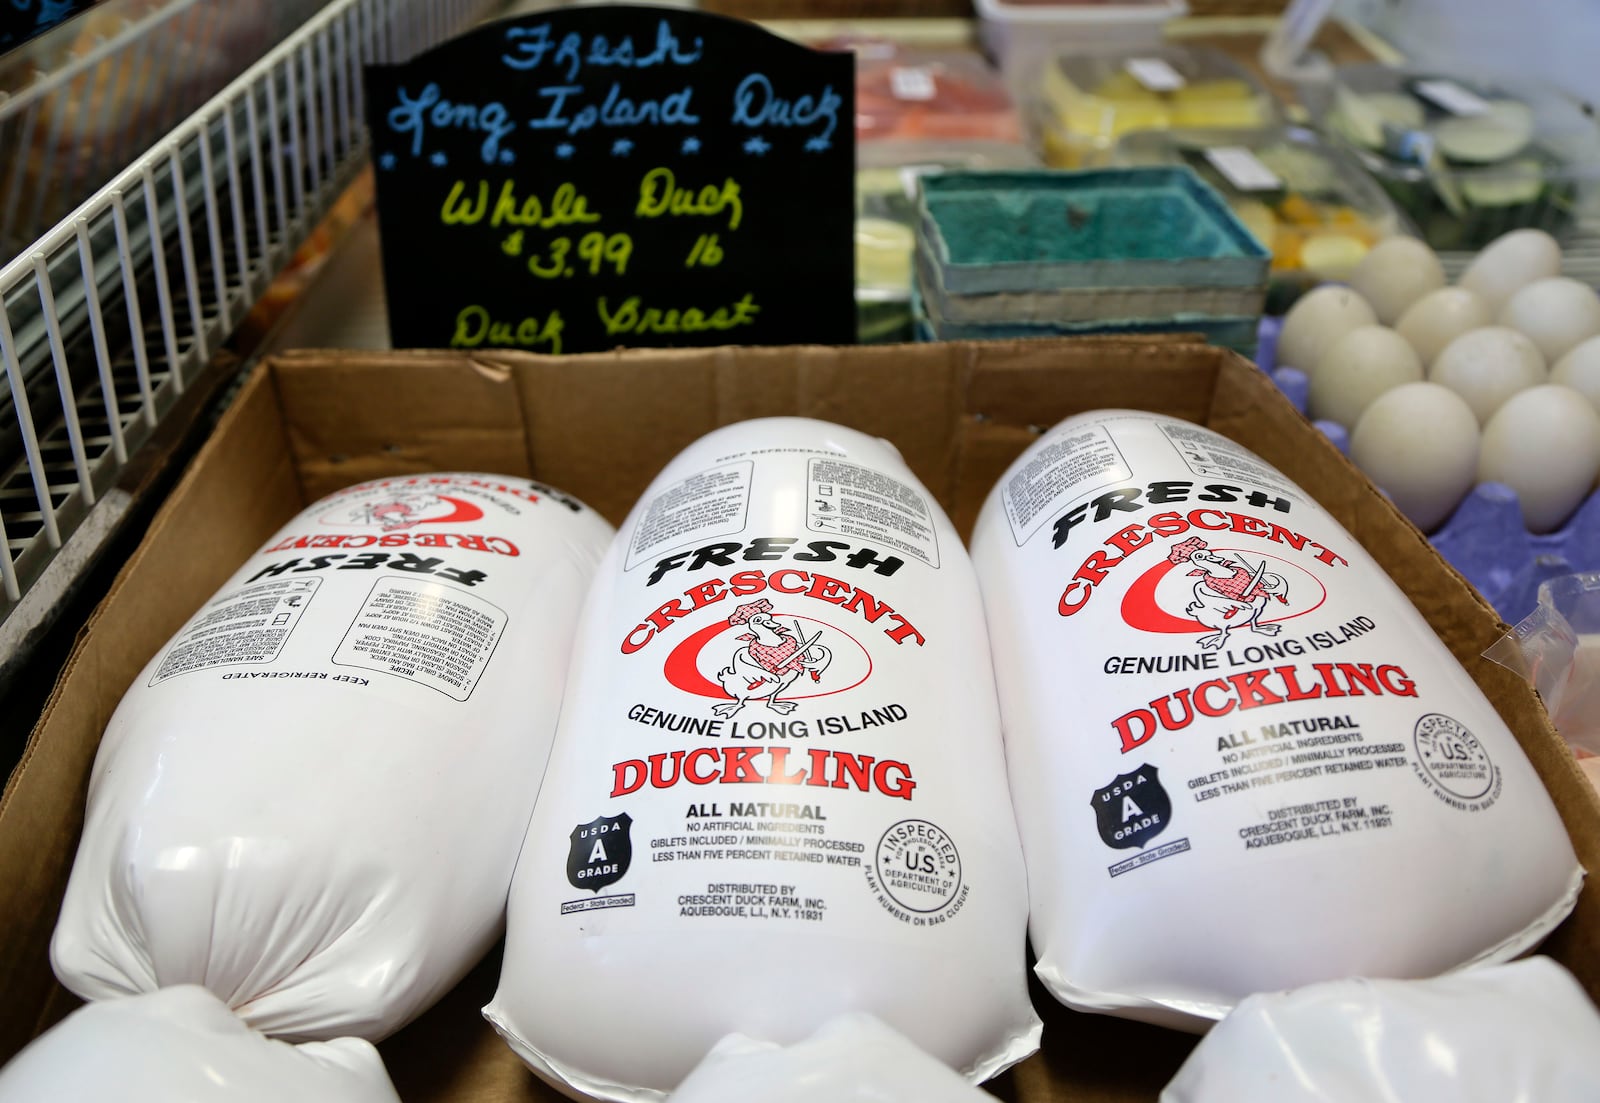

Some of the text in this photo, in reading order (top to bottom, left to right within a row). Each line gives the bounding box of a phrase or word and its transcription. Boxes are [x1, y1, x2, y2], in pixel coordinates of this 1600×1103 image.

[502, 18, 703, 82] Fresh
[386, 82, 515, 163] Long
[529, 82, 699, 134] Island
[732, 73, 842, 139] Duck
[441, 167, 743, 230] Whole Duck
[450, 294, 760, 355] Duck Breast
[1052, 481, 1291, 549] FRESH
[263, 533, 520, 558] CRESCENT
[244, 553, 488, 586] FRESH
[647, 537, 904, 586] FRESH
[1058, 508, 1348, 617] CRESCENT
[620, 569, 925, 655] CRESCENT
[422, 640, 449, 652] WITHOUT
[430, 635, 447, 644] RACK
[1103, 615, 1376, 675] GENUINE LONG ISLAND
[369, 647, 391, 656] ENTIRE
[391, 652, 410, 660] PRICK
[396, 646, 413, 654] WITH
[412, 650, 444, 664] LIBERALLY
[458, 646, 477, 658] ROAST
[459, 653, 475, 664] WITH
[387, 657, 401, 665] AND
[389, 664, 414, 676] RECIPE
[415, 665, 436, 675] GIBLET
[419, 659, 445, 671] (SLASH)
[444, 661, 468, 675] SEASON
[445, 654, 472, 670] POULTRY
[222, 672, 369, 686] KEEP REFRIGERATED
[436, 672, 461, 687] REMOVE
[444, 668, 464, 681] SCORE
[1111, 663, 1418, 755] DUCKLING
[627, 703, 908, 740] GENUINE LONG ISLAND
[1217, 715, 1360, 752] ALL NATURAL
[1418, 717, 1479, 749] INSPECTED
[1222, 732, 1364, 765] NO ARTIFICIAL INGREDIENTS
[1439, 741, 1473, 761] U.S.
[610, 746, 917, 801] DUCKLING
[1188, 742, 1406, 790] GIBLETS INCLUDED MINIMALLY PROCESSED
[1102, 774, 1147, 802] USDA
[1194, 756, 1408, 803] LESS THAN FIVE PERCENT RETAINED WATER
[686, 803, 827, 820] ALL NATURAL
[1121, 795, 1144, 824] A
[1268, 796, 1358, 821] DISTRIBUTED BY
[581, 822, 620, 838] USDA
[687, 821, 825, 835] NO ARTIFICIAL INGREDIENTS
[1114, 813, 1161, 841] GRADE
[1239, 818, 1299, 840] CRESCENT
[1300, 812, 1333, 828] DUCK
[1369, 804, 1393, 817] INC.
[651, 837, 687, 848] GIBLETS
[689, 836, 738, 847] INCLUDED
[746, 836, 801, 848] MINIMALLY
[803, 838, 865, 853] PROCESSED
[884, 824, 956, 864] INSPECTED
[1245, 827, 1320, 851] AQUEBOGUE,
[588, 838, 608, 864] A
[653, 850, 862, 867] LESS THAN FIVE PERCENT RETAINED WATER
[577, 864, 619, 879] GRADE
[906, 850, 938, 876] U.S.
[884, 869, 953, 889] DEPARTMENT OF
[890, 879, 947, 897] AGRICULTURE
[708, 883, 795, 896] DISTRIBUTED BY
[864, 864, 970, 927] PLANT NUMBER ON BAG CLOSURE
[563, 896, 633, 912] Federal State Graded
[678, 894, 828, 910] CRESCENT DUCK FARM, INC.
[679, 906, 748, 918] AQUEBOGUE,
[770, 907, 791, 919] N.Y.
[794, 909, 823, 921] 11931
